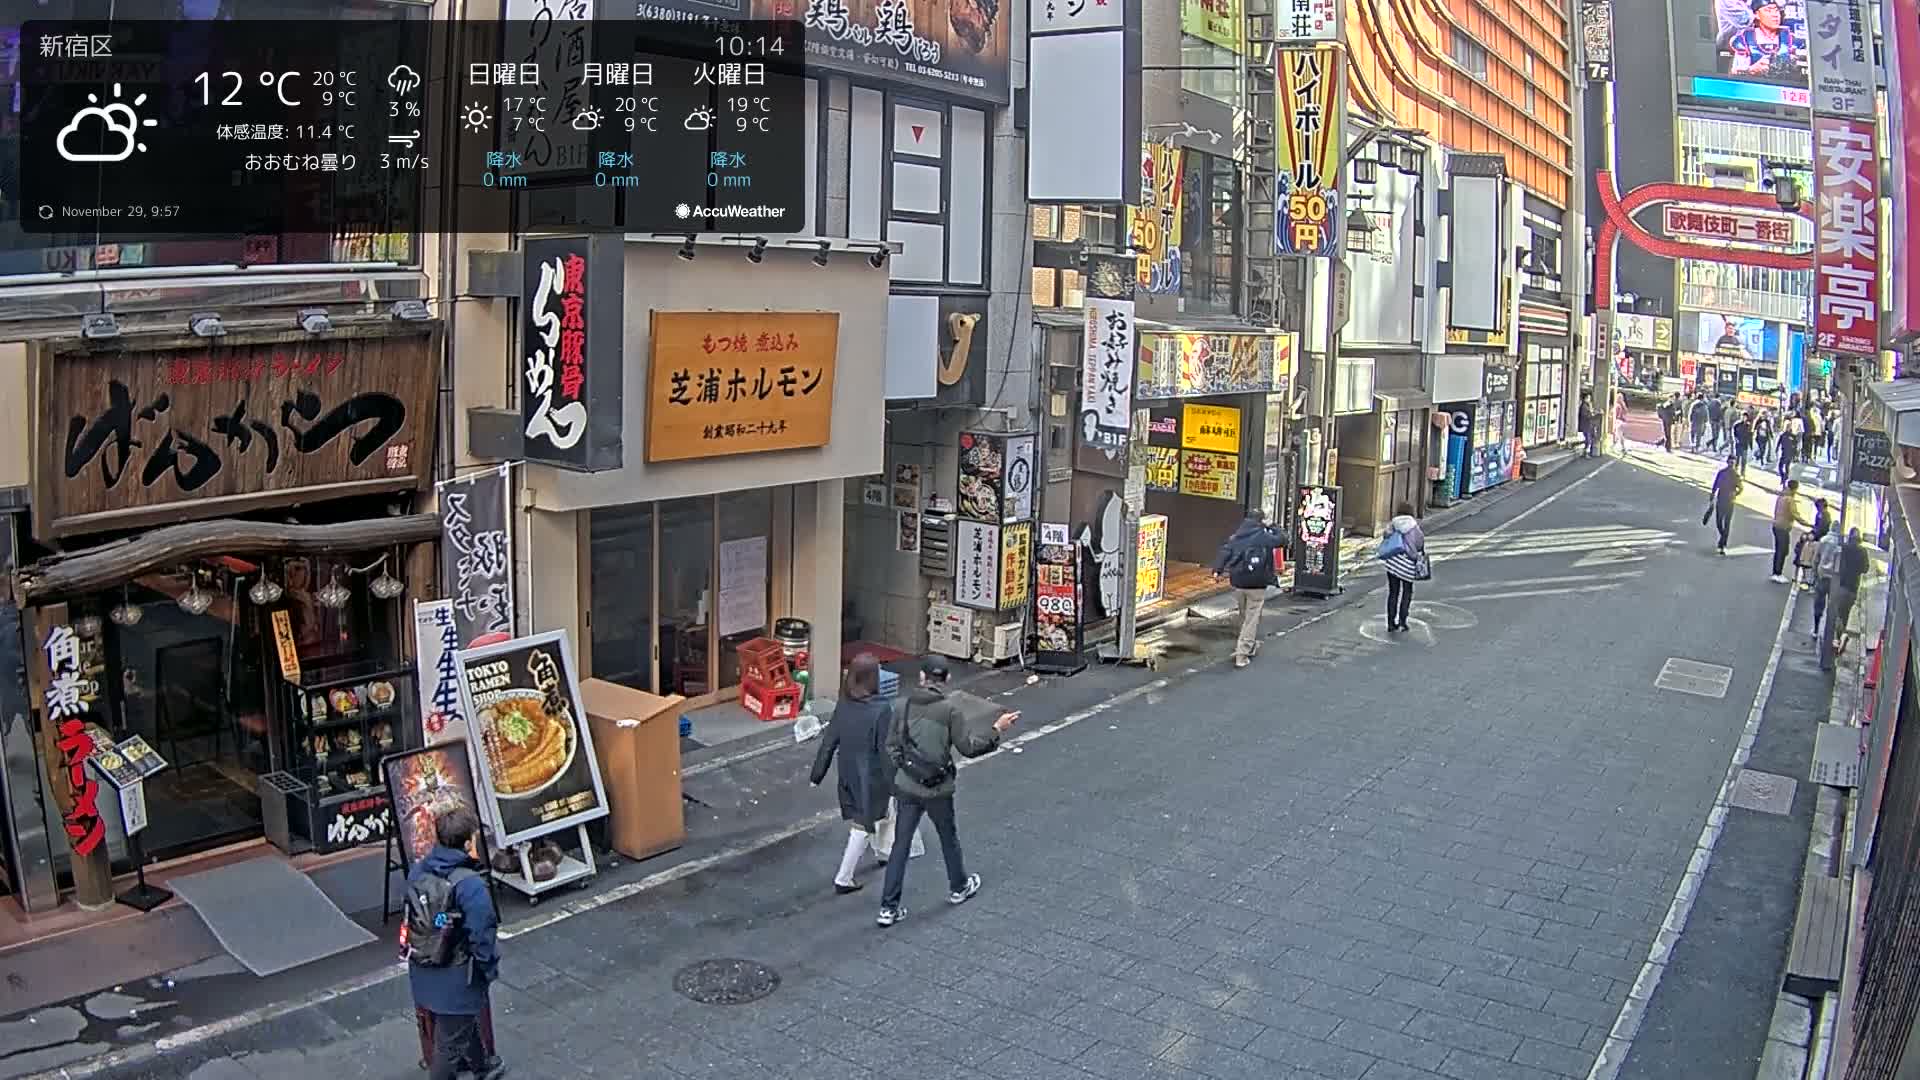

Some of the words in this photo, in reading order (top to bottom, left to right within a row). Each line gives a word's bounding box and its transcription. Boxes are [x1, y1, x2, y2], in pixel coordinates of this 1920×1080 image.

[1589, 63, 1609, 79] 7F
[1831, 97, 1856, 112] 3F
[1294, 51, 1321, 190] ハイボール
[1289, 196, 1326, 251] 50円
[1669, 211, 1792, 243] 歌舞伎町一番街
[1819, 123, 1876, 330] 安楽亭
[560, 253, 586, 401] 東京豚骨
[703, 333, 748, 354] もつ焼
[755, 331, 799, 352] 煮込み
[1817, 332, 1837, 347] 2F
[668, 365, 823, 406] 芝浦ホルモン
[1103, 431, 1128, 446] B1F
[971, 527, 983, 600] 芝浦ホルモン
[465, 659, 509, 681] TOKYO
[469, 673, 512, 694] RAMEN
[472, 688, 502, 706] SHOP
